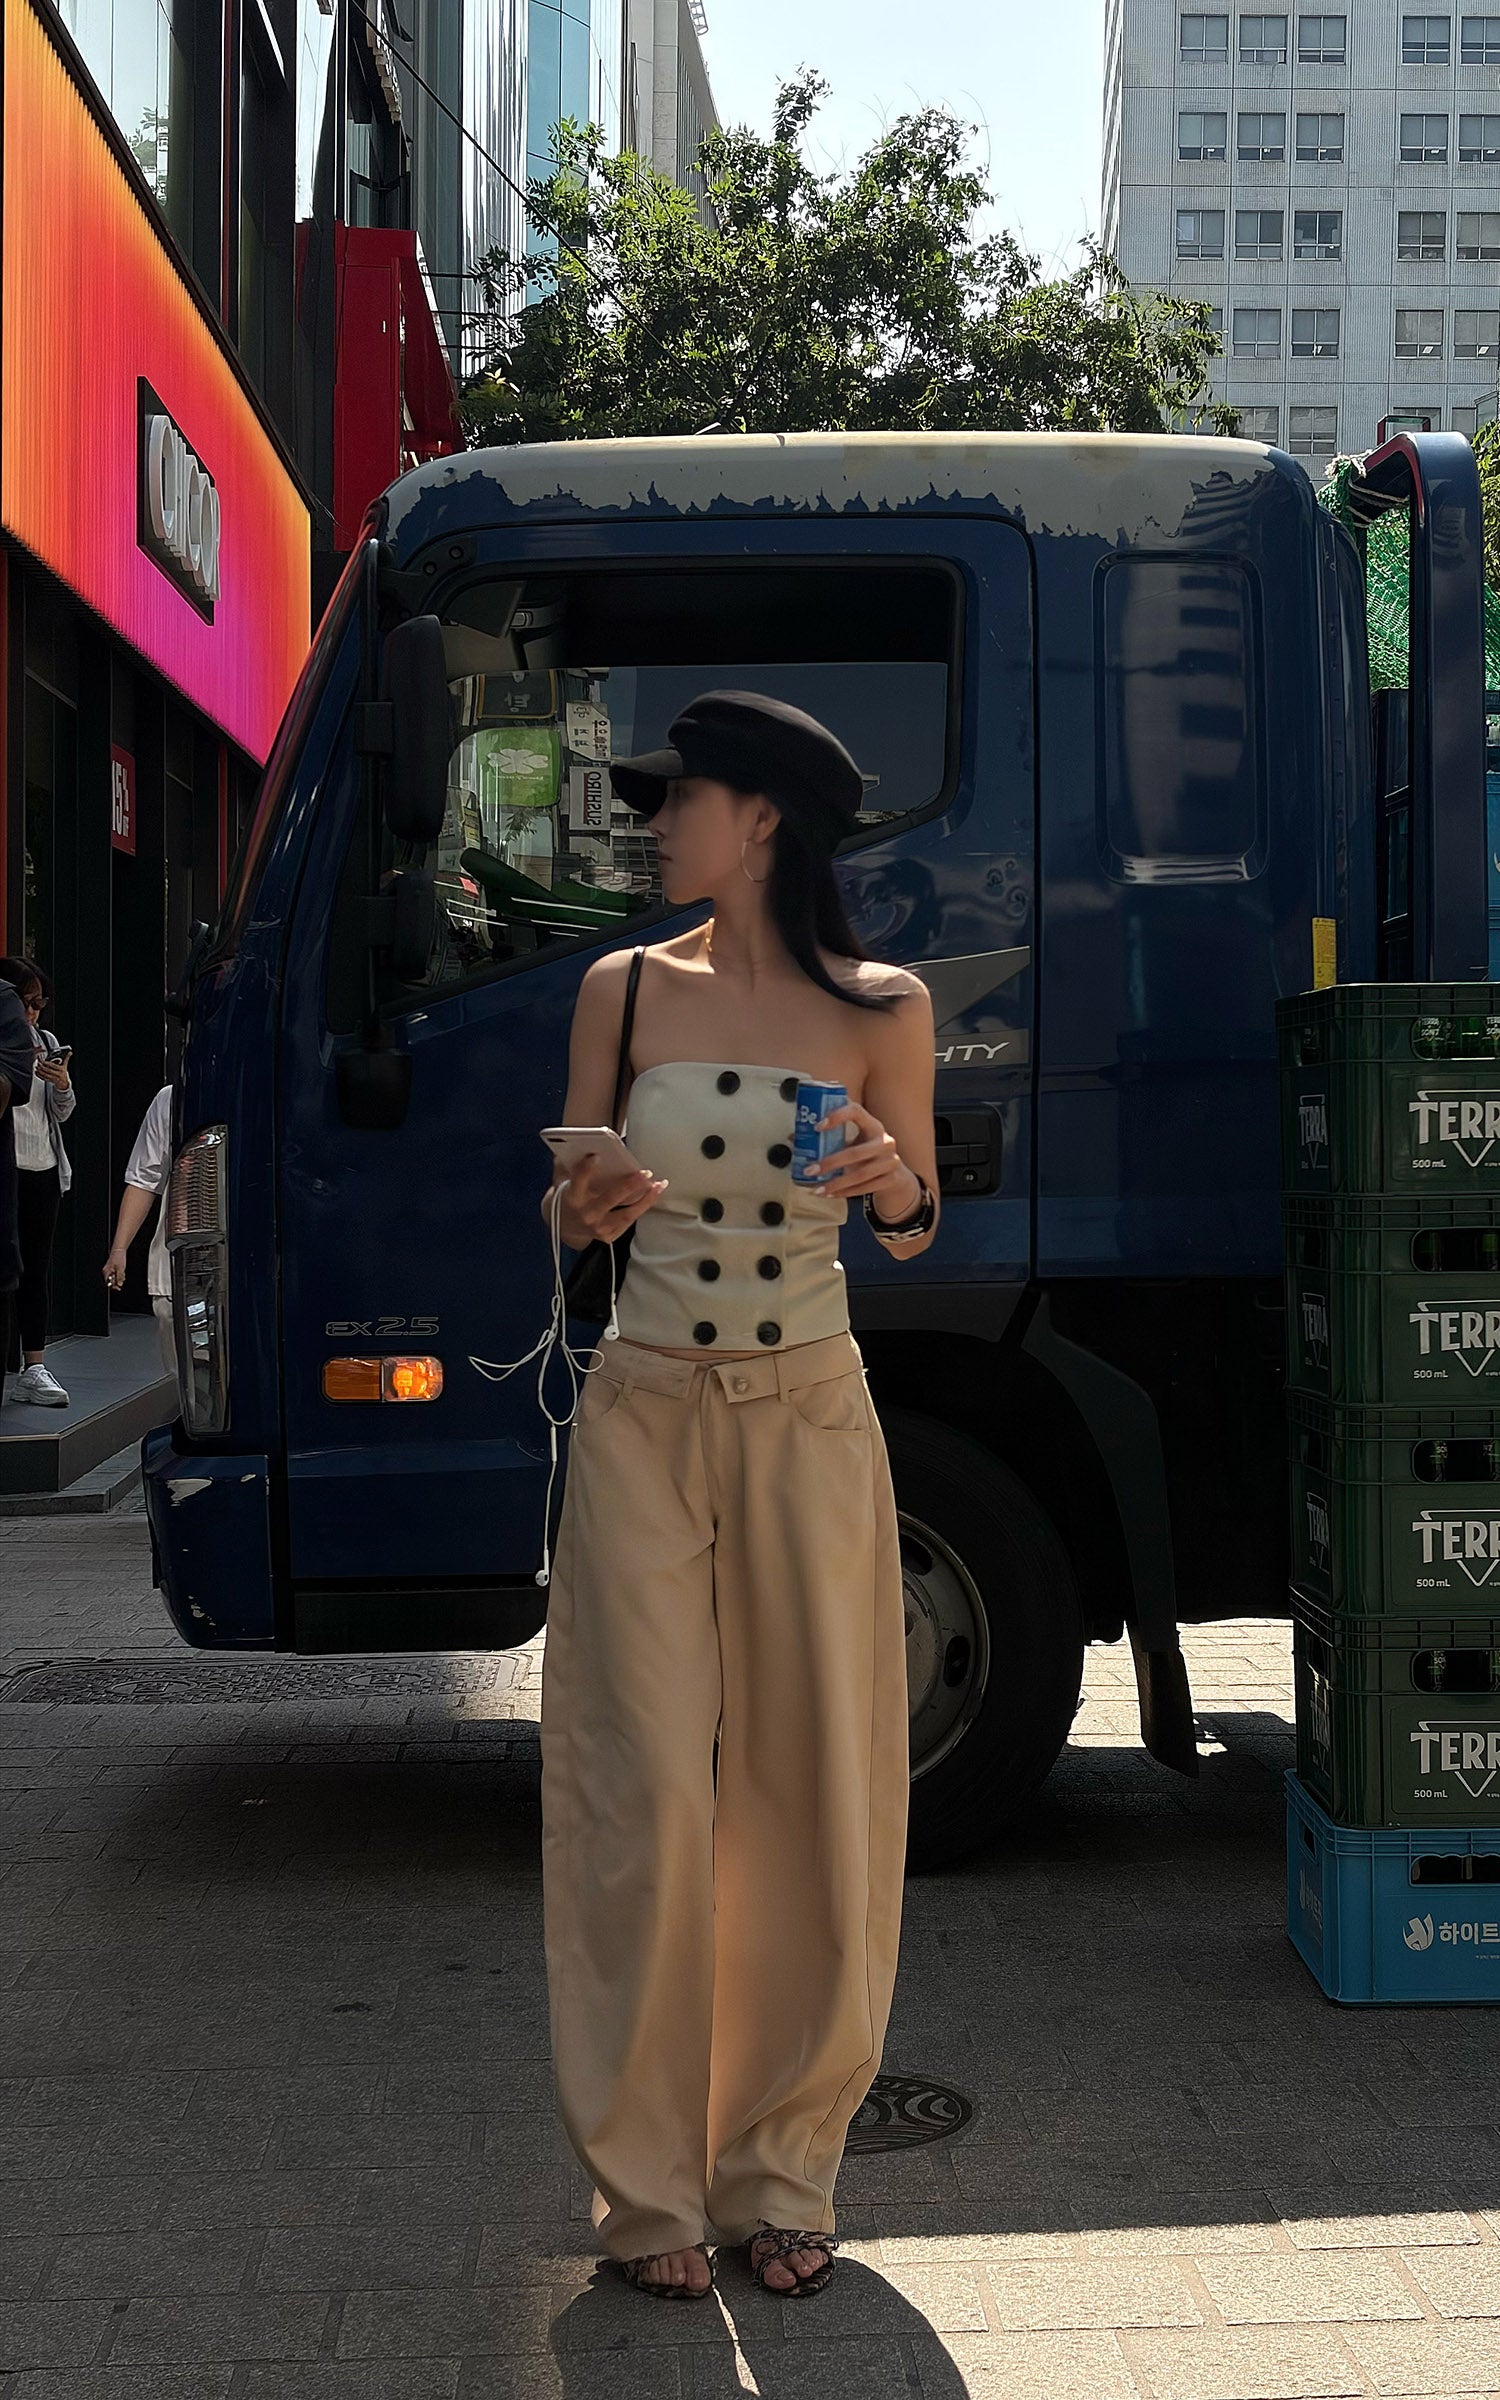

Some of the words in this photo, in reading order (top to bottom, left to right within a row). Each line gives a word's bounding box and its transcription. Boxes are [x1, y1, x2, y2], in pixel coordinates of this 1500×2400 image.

[1412, 1159, 1431, 1169] 500
[1413, 1369, 1432, 1379] 500
[1416, 1578, 1435, 1588] 500
[1413, 1789, 1432, 1799] 500
